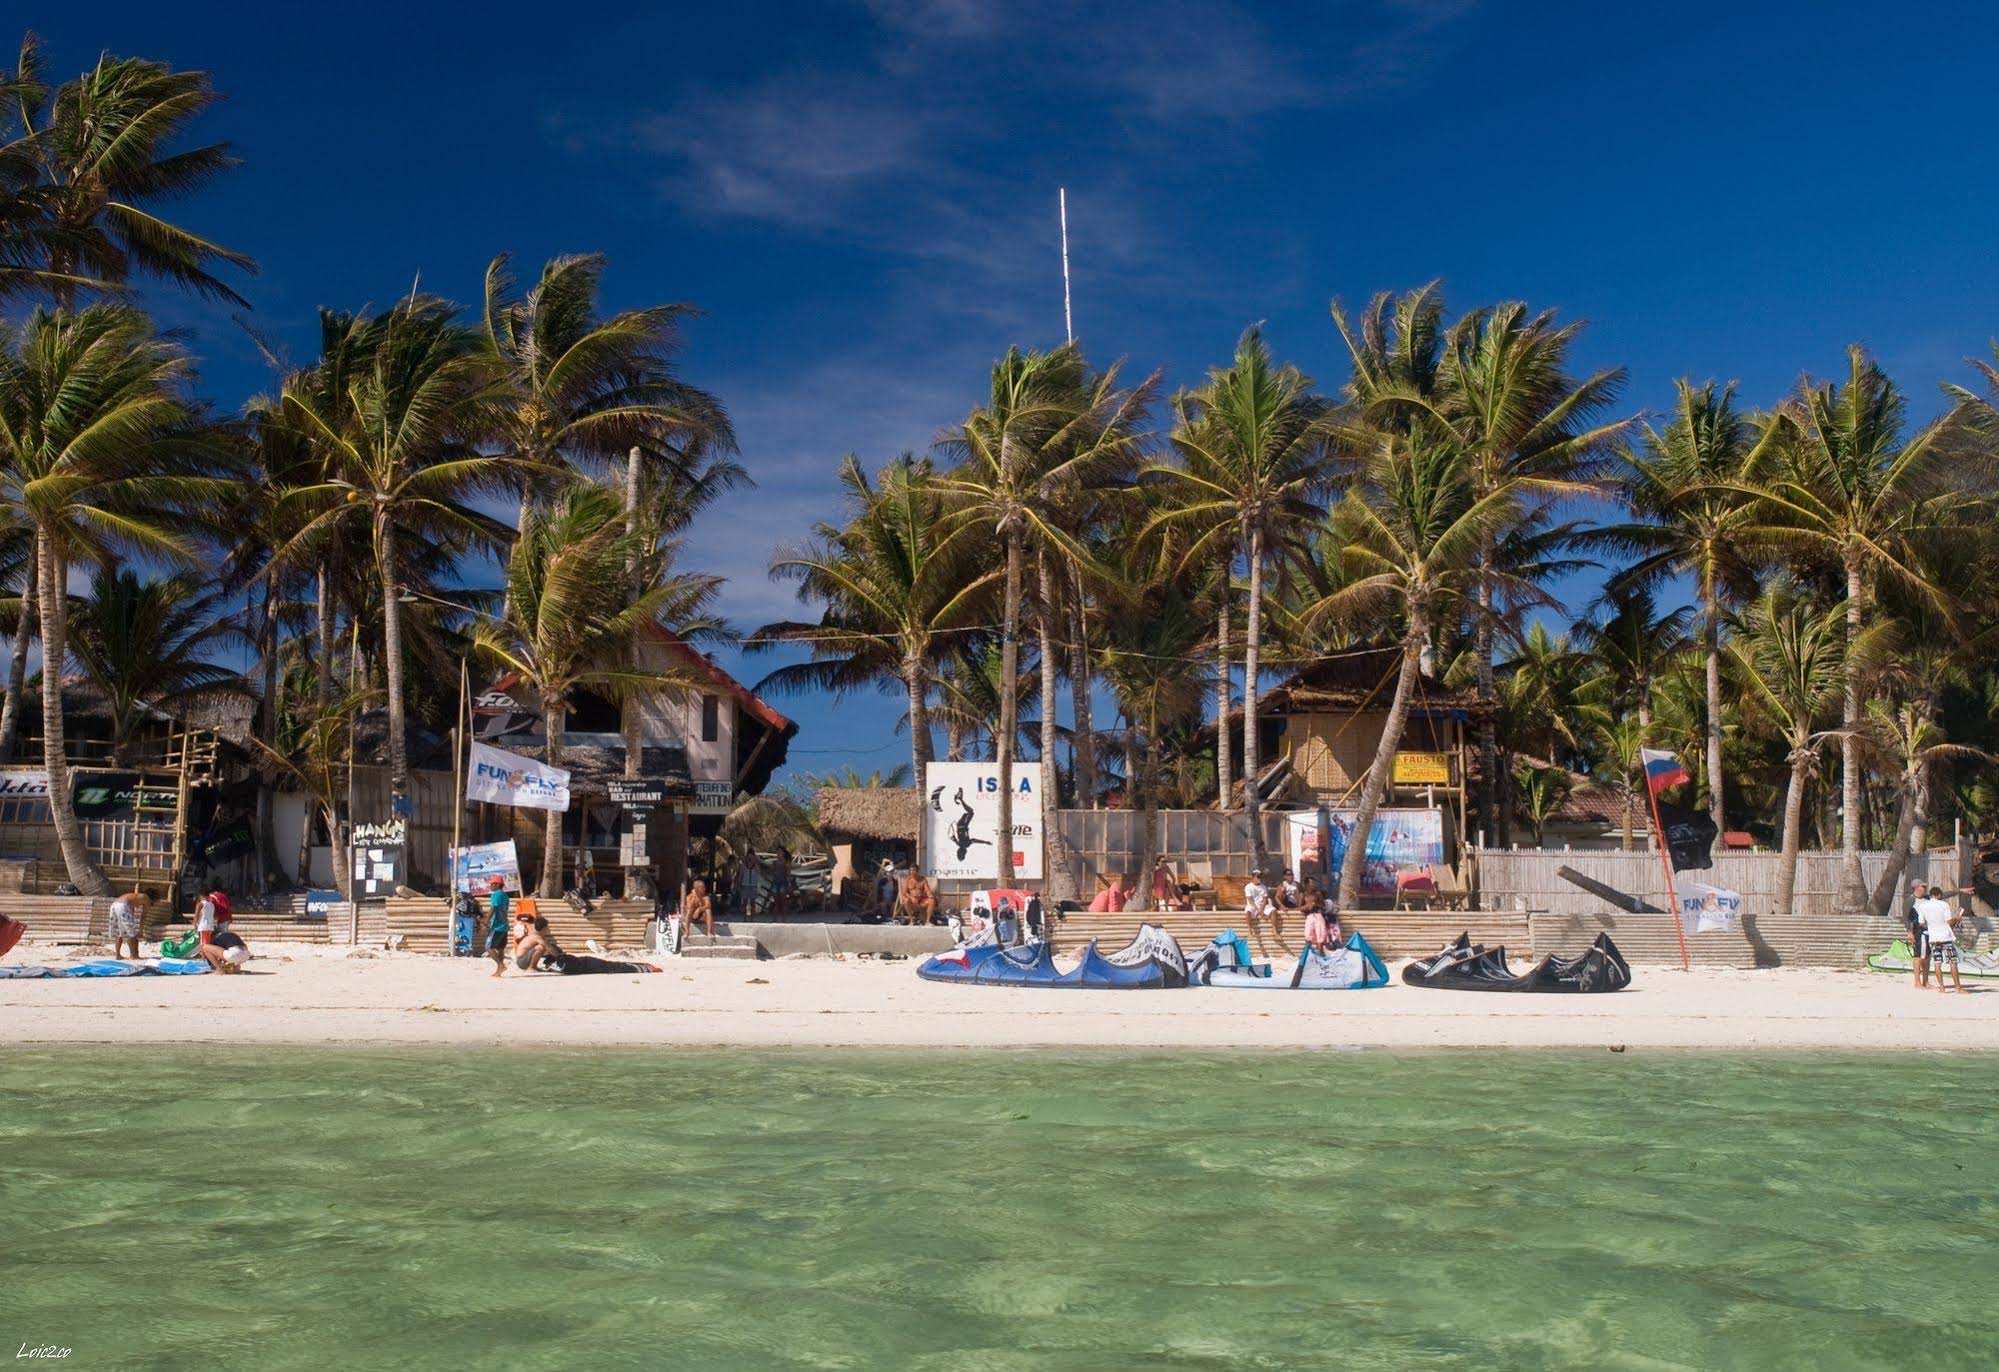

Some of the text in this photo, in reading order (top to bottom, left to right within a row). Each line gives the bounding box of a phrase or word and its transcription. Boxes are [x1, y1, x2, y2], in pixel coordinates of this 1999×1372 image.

[1403, 755, 1445, 763] FAUSTO
[977, 777, 1032, 793] ISA
[610, 792, 663, 802] RESTAURANT
